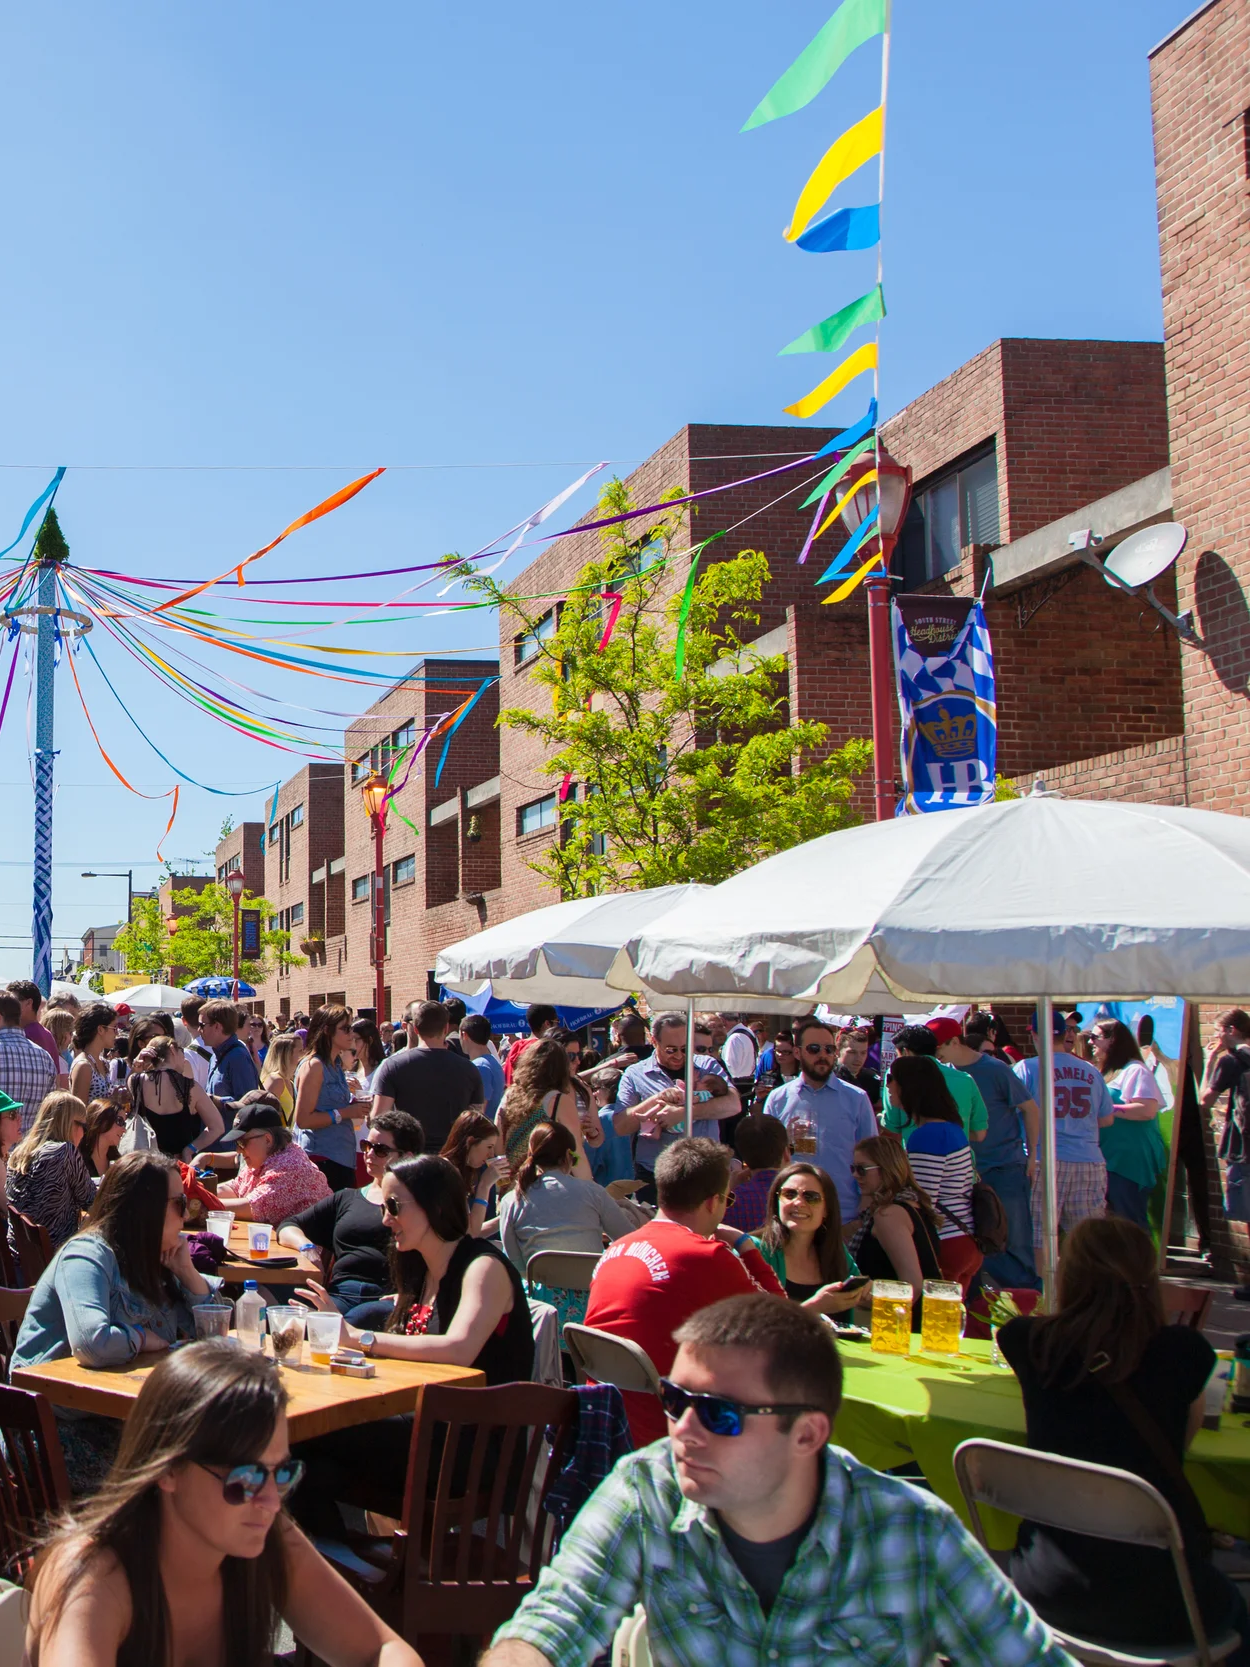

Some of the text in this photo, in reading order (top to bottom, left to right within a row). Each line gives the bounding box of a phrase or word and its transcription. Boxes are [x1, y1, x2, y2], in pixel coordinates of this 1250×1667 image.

[925, 758, 994, 805] HB
[1054, 1067, 1095, 1085] AMELS
[1054, 1086, 1091, 1118] 35
[624, 1240, 670, 1281] MÜNCHEN
